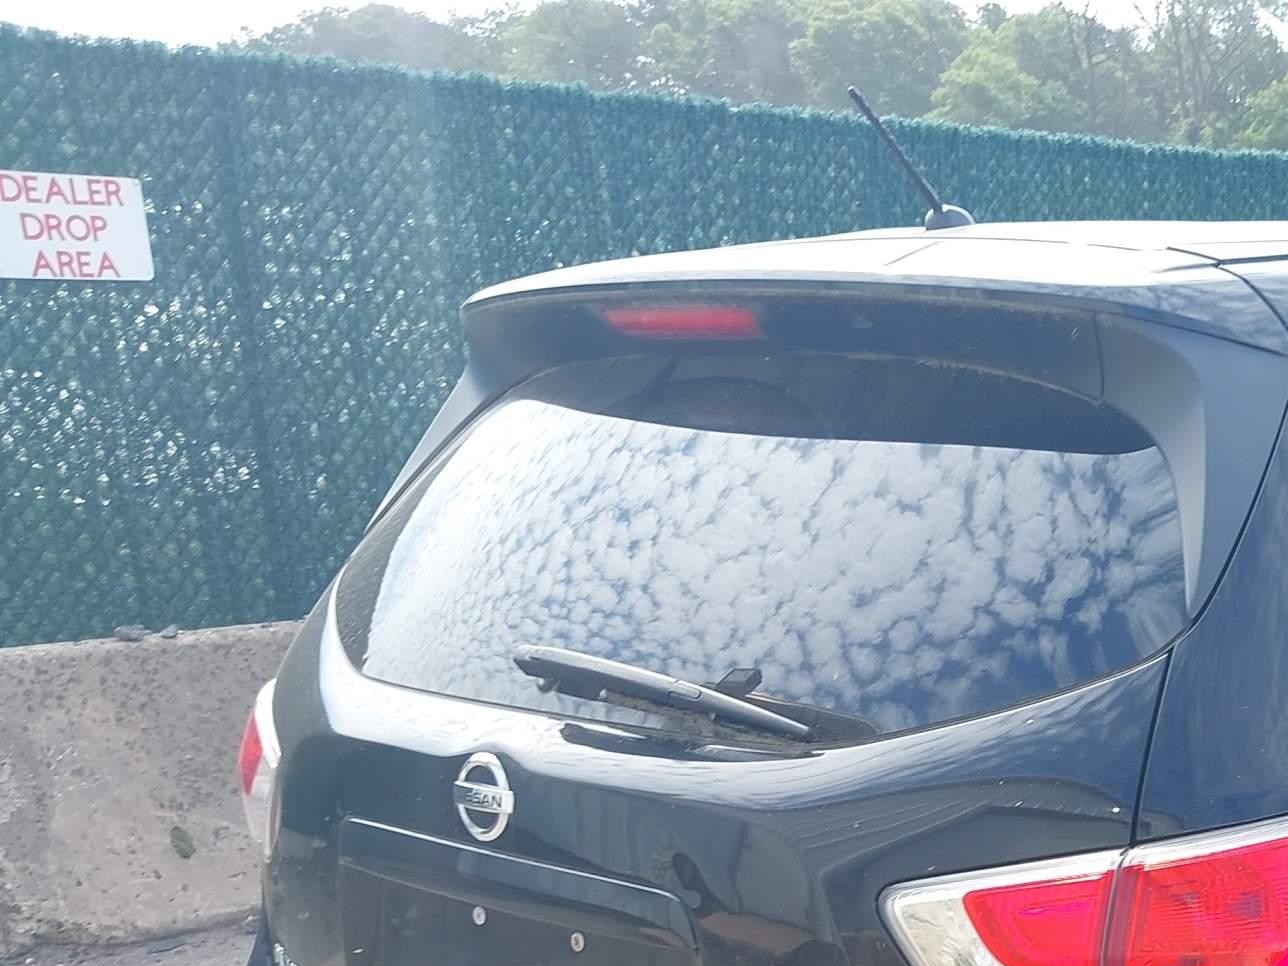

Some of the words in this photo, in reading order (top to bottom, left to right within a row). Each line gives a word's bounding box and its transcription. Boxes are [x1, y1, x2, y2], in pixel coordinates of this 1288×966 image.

[0, 173, 124, 207] DEALER
[19, 212, 108, 242] DROP
[32, 250, 121, 278] AREA
